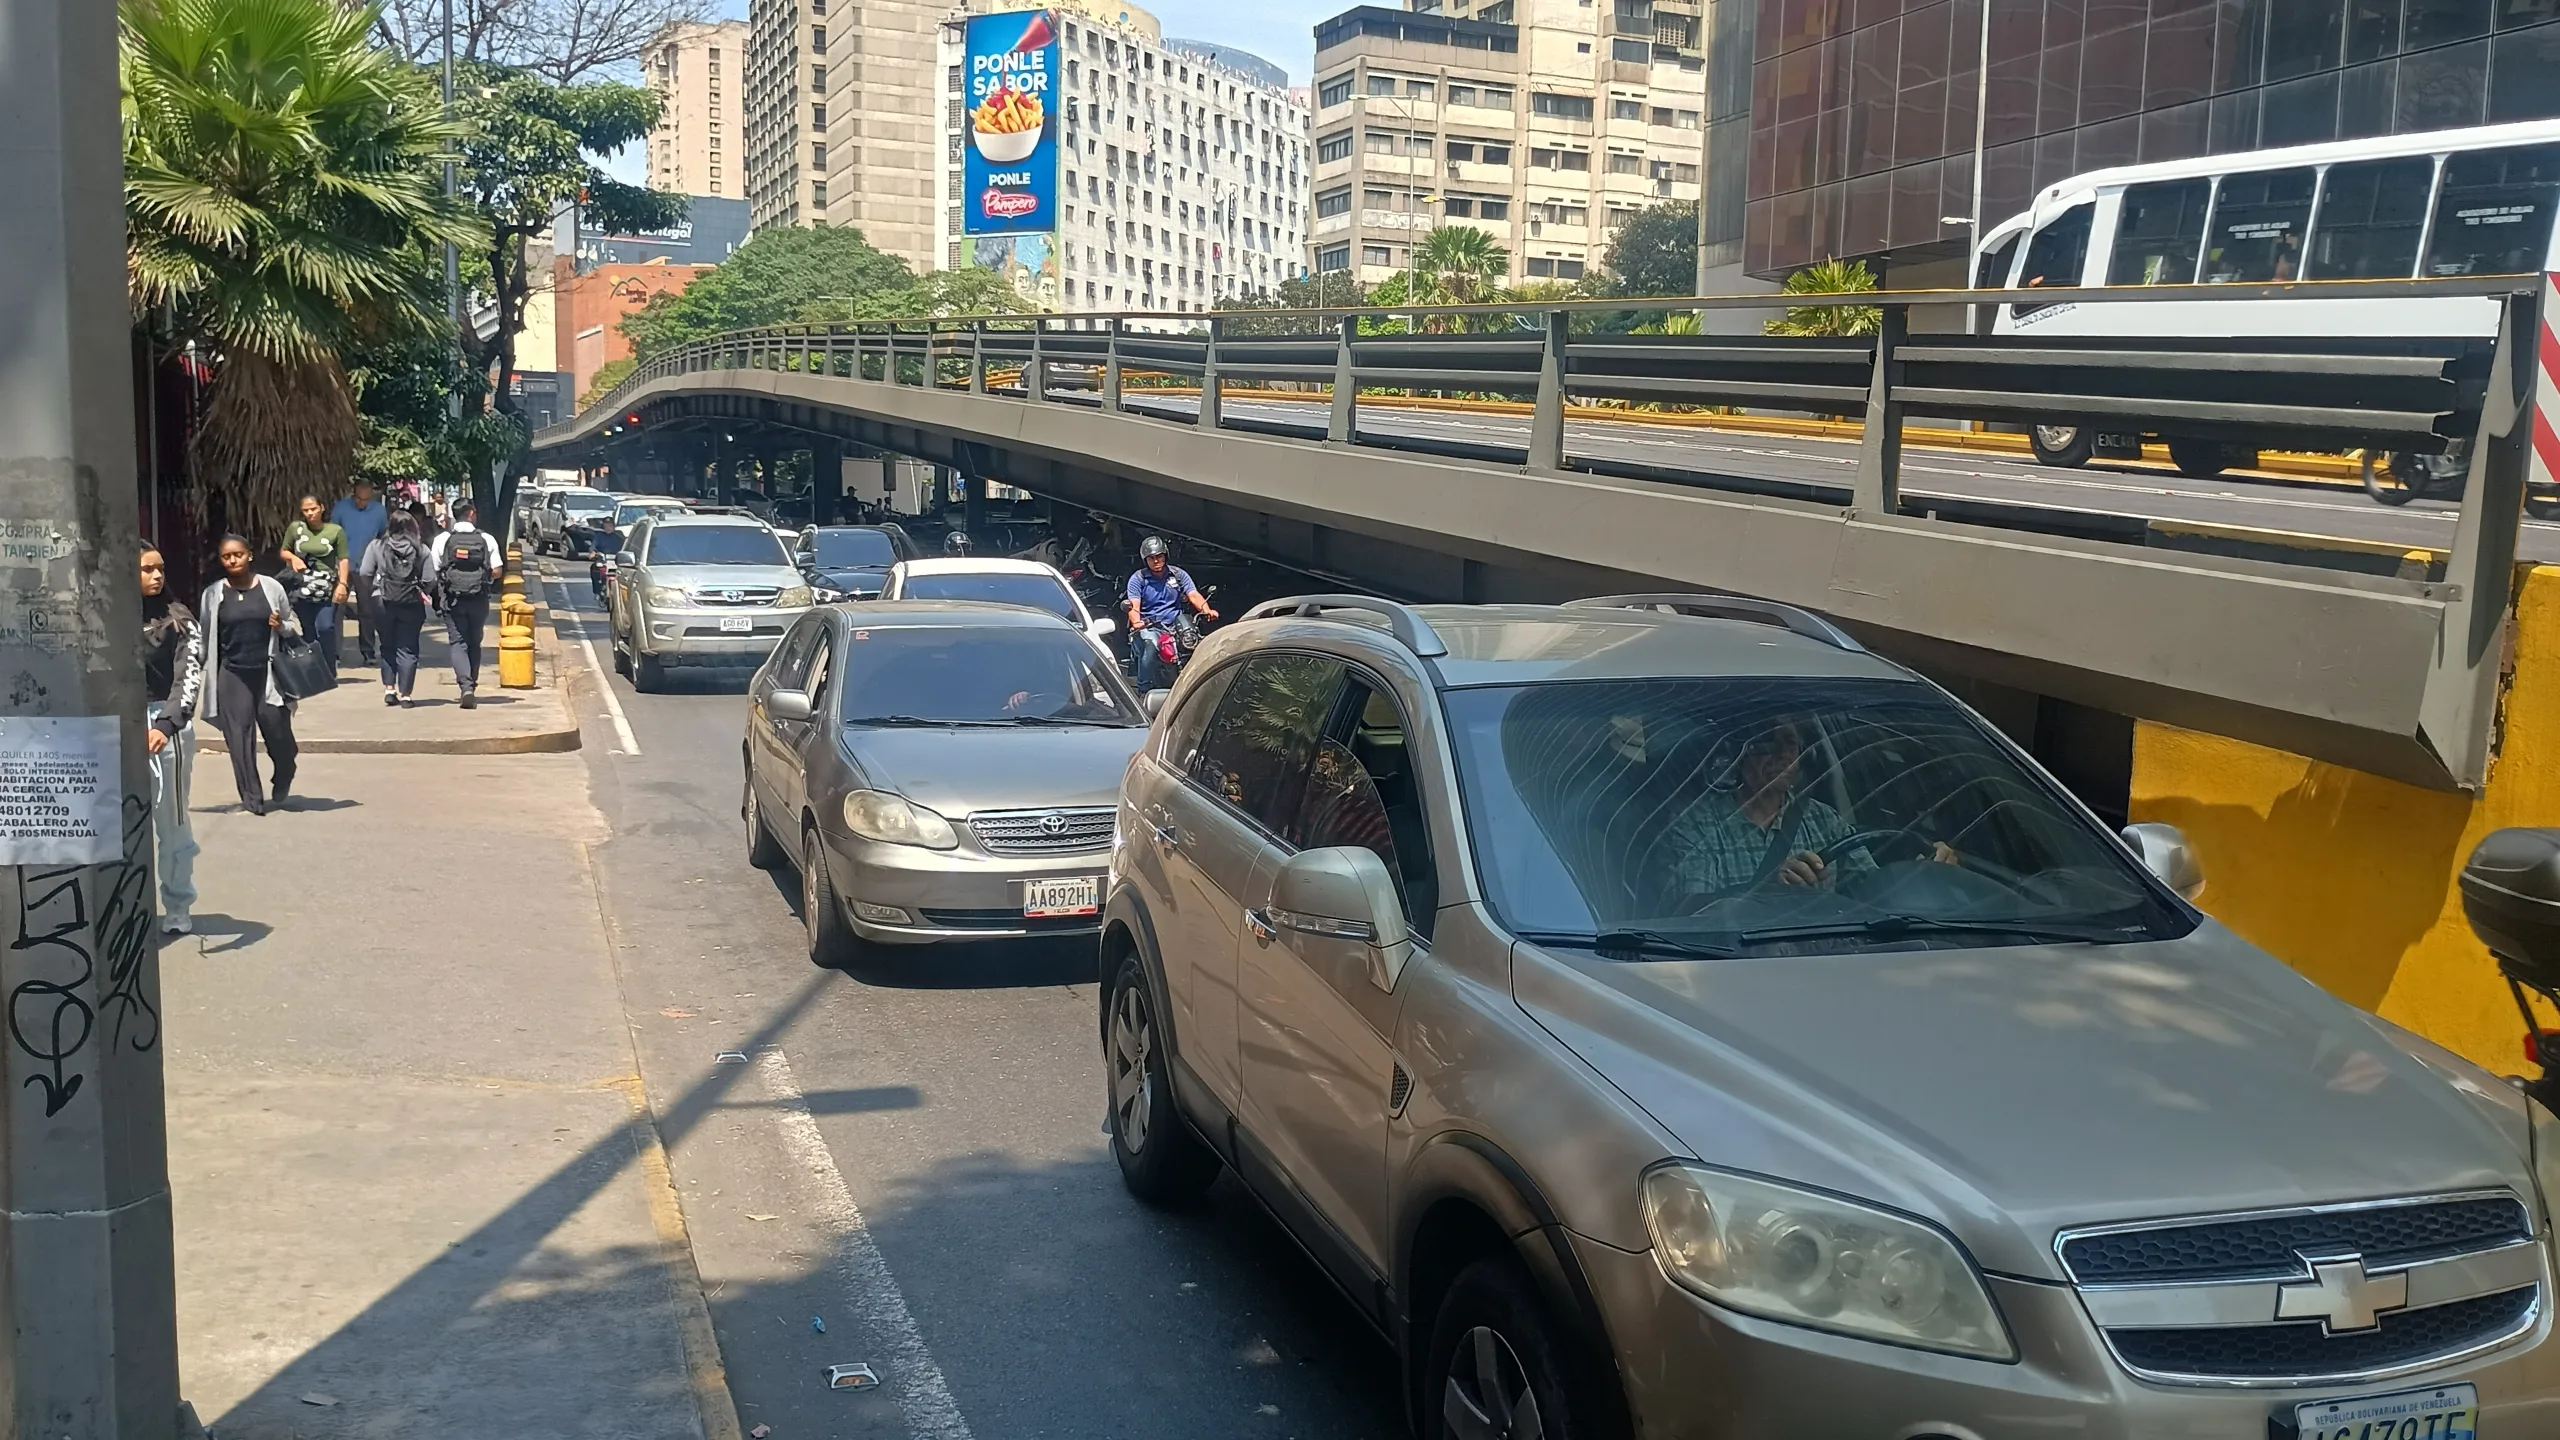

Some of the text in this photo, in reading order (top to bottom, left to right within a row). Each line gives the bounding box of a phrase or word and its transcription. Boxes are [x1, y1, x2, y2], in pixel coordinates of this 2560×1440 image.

[974, 50, 1045, 75] PONLE
[973, 72, 1048, 96] SABOR
[988, 172, 1031, 186] PONLE
[983, 190, 1038, 214] Pampero
[0, 751, 35, 760] QUILER
[38, 751, 60, 760] 140$
[69, 776, 98, 784] PARA
[13, 786, 52, 794] CERCA
[55, 786, 70, 794] LA
[73, 786, 95, 794] PZA
[72, 819, 90, 827] AV
[11, 829, 99, 838] 150$MENSUAL
[1030, 886, 1093, 907] AA892HI
[2357, 1404, 2408, 1419] BOLIVARIANA
[2409, 1402, 2419, 1412] DE
[2420, 1396, 2462, 1411] VENEZUELA
